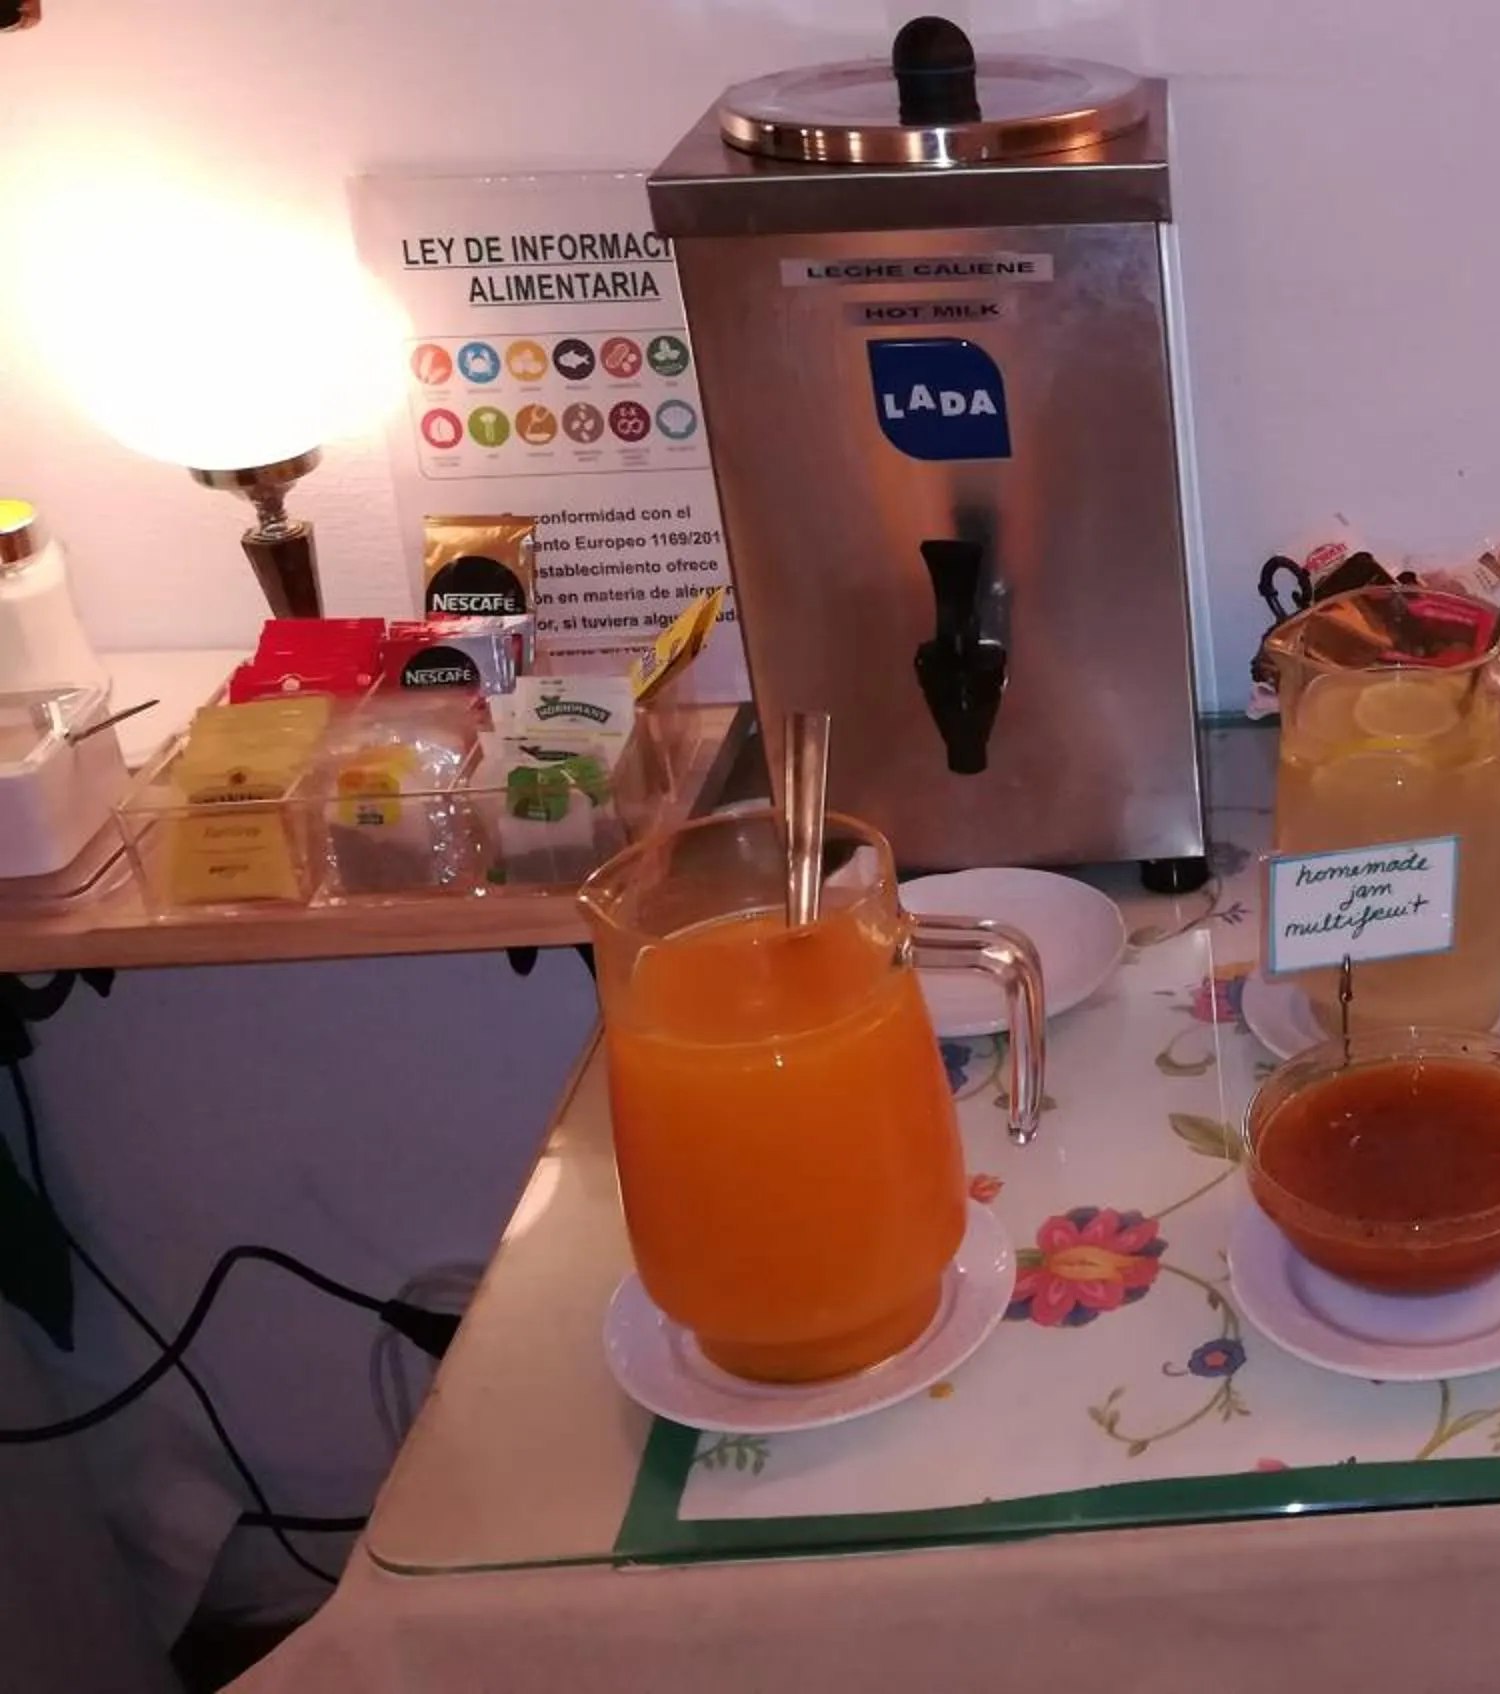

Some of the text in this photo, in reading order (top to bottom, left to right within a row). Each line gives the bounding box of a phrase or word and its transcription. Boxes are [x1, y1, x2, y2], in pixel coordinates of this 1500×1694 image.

[402, 238, 455, 265] LEY
[465, 237, 503, 264] DE
[806, 261, 1036, 279] LECHE CALIENE
[469, 271, 660, 301] ALIMENTARIA
[865, 303, 1000, 320] HOT MILK
[882, 383, 998, 420] LADA
[641, 508, 672, 522] con
[677, 505, 691, 519] el
[575, 536, 646, 551] Europeo
[651, 530, 721, 547] 1169/201
[666, 559, 719, 573] ofrece
[558, 592, 578, 604] en
[583, 586, 645, 602] materia
[650, 583, 671, 599] de
[562, 617, 577, 630] si
[581, 615, 639, 629] tuviera
[1295, 848, 1430, 886] homemade
[1339, 881, 1393, 911] jam
